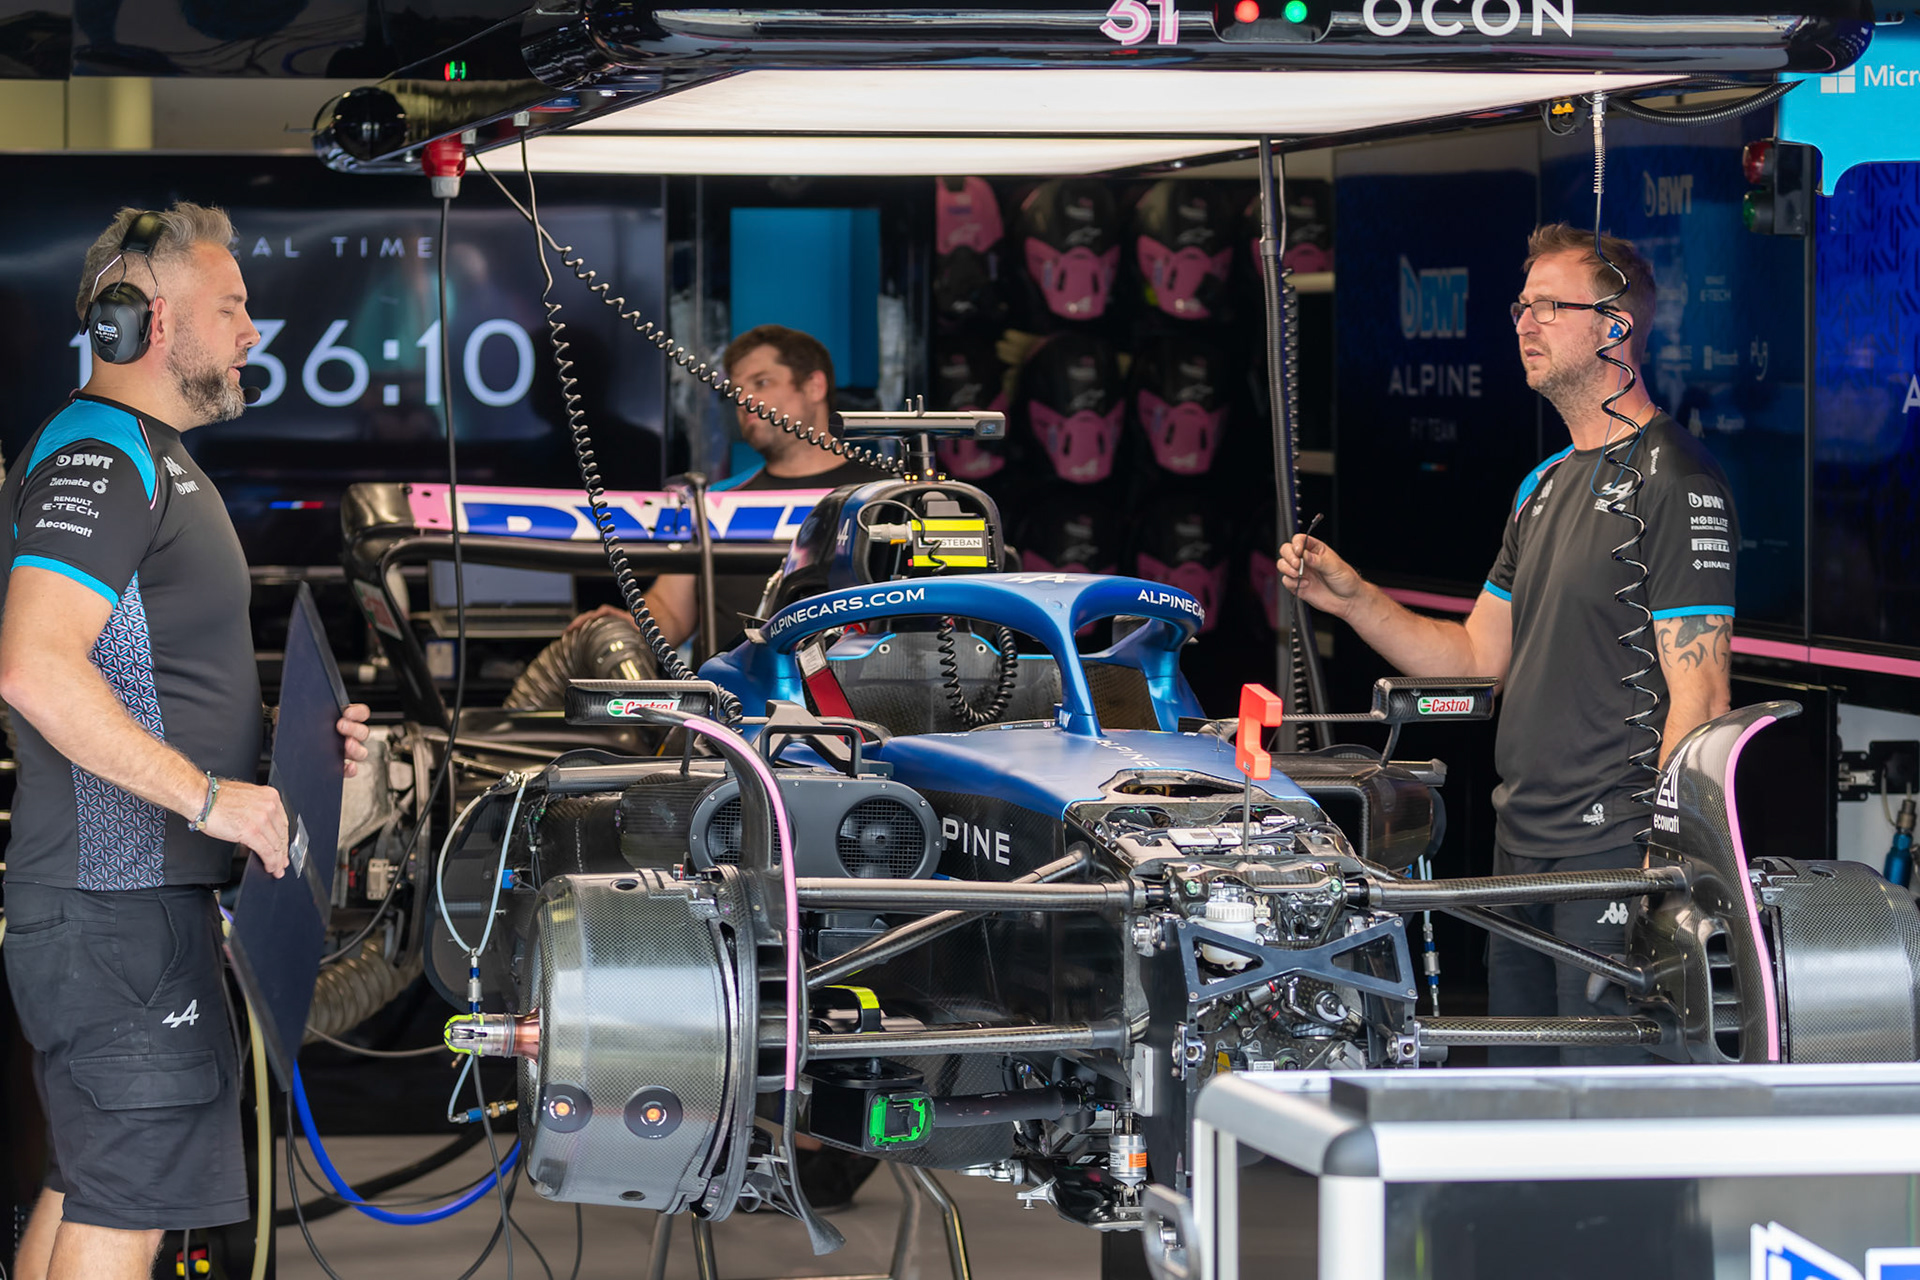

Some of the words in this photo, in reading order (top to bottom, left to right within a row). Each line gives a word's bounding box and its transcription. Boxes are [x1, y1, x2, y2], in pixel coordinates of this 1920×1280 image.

[1363, 0, 1573, 37] OCON
[1864, 65, 1920, 87] Micr
[1658, 175, 1693, 216] BWT
[331, 236, 433, 258] TIME
[1419, 267, 1468, 338] BWT
[1388, 365, 1482, 397] ALPINE
[72, 453, 114, 470] BWT
[42, 502, 100, 519] E-TECH
[53, 495, 93, 506] RENAULT
[46, 520, 93, 538] ecowatt
[940, 538, 982, 547] STEBAN
[770, 587, 925, 639] ALPINECARS.COM
[1431, 698, 1470, 713] Castrol
[1653, 812, 1680, 834] ecowatt
[942, 816, 1010, 866] PINE
